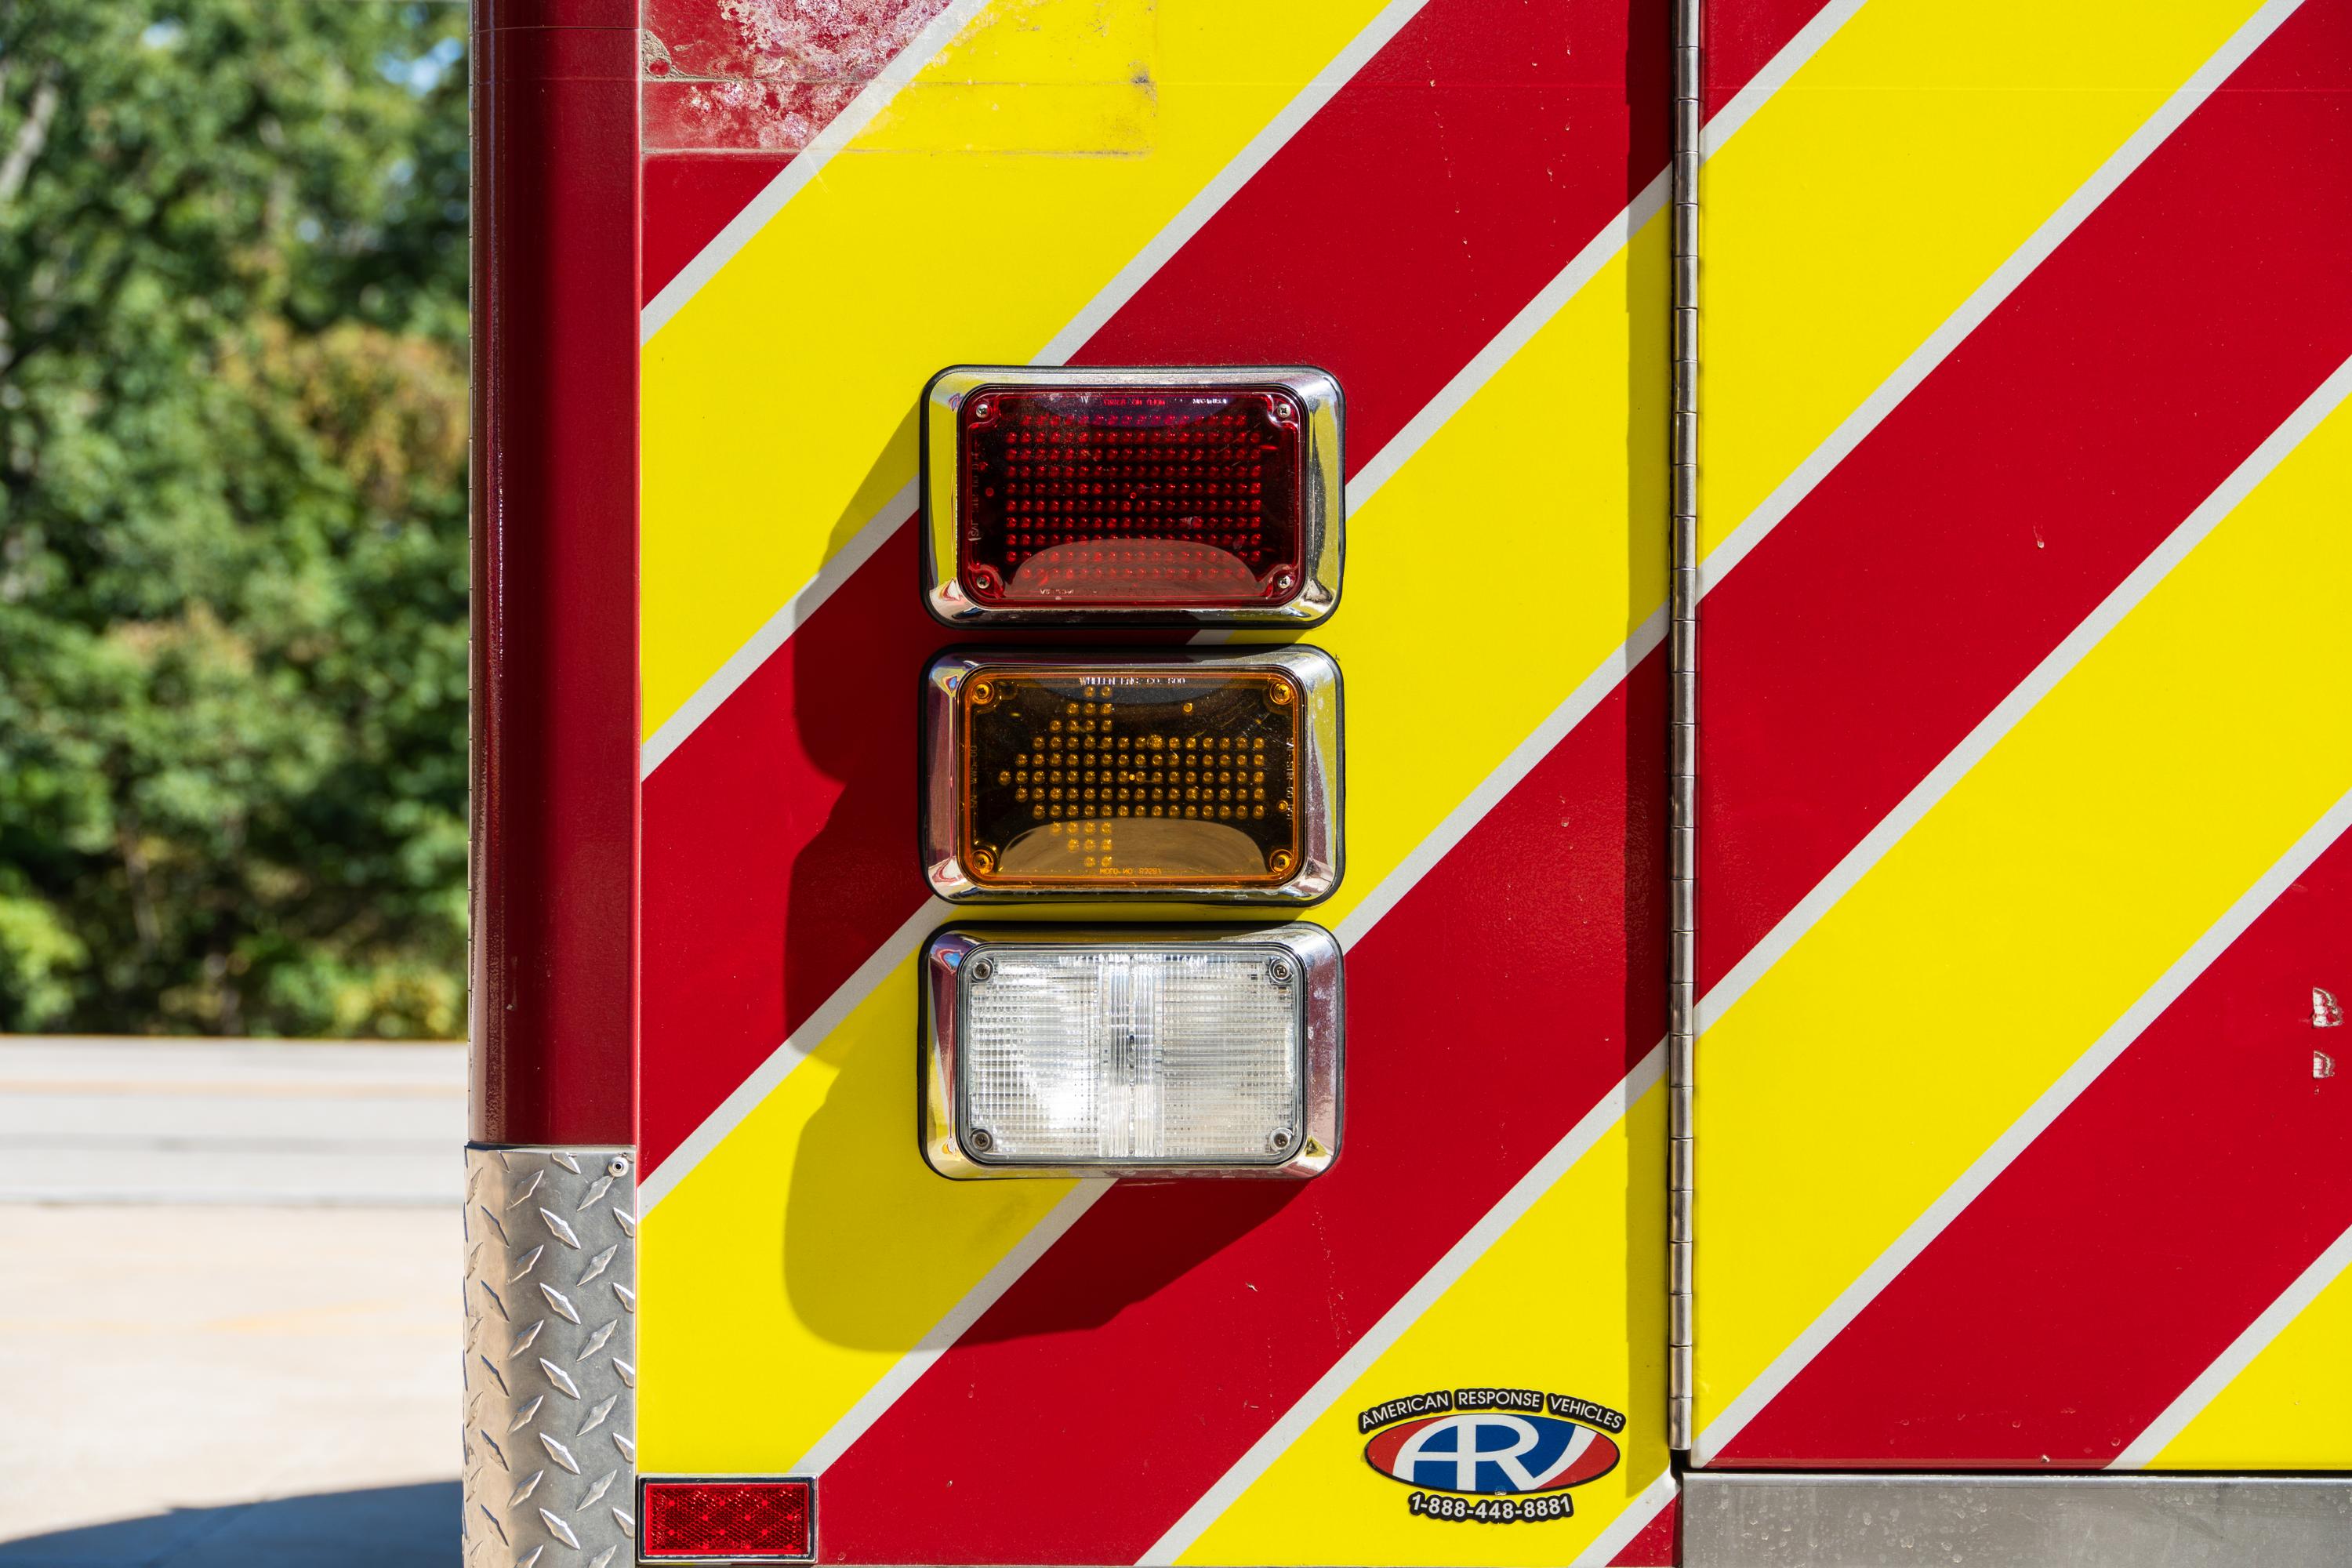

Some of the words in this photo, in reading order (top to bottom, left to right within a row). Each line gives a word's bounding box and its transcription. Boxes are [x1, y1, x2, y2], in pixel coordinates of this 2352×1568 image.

[1362, 1393, 1450, 1429] AMERICAN
[1457, 1391, 1541, 1408] RESPONSE
[1550, 1396, 1622, 1429] VEHICLES
[1392, 1414, 1598, 1491] ARV
[1412, 1494, 1571, 1519] 1-888-448-8881
